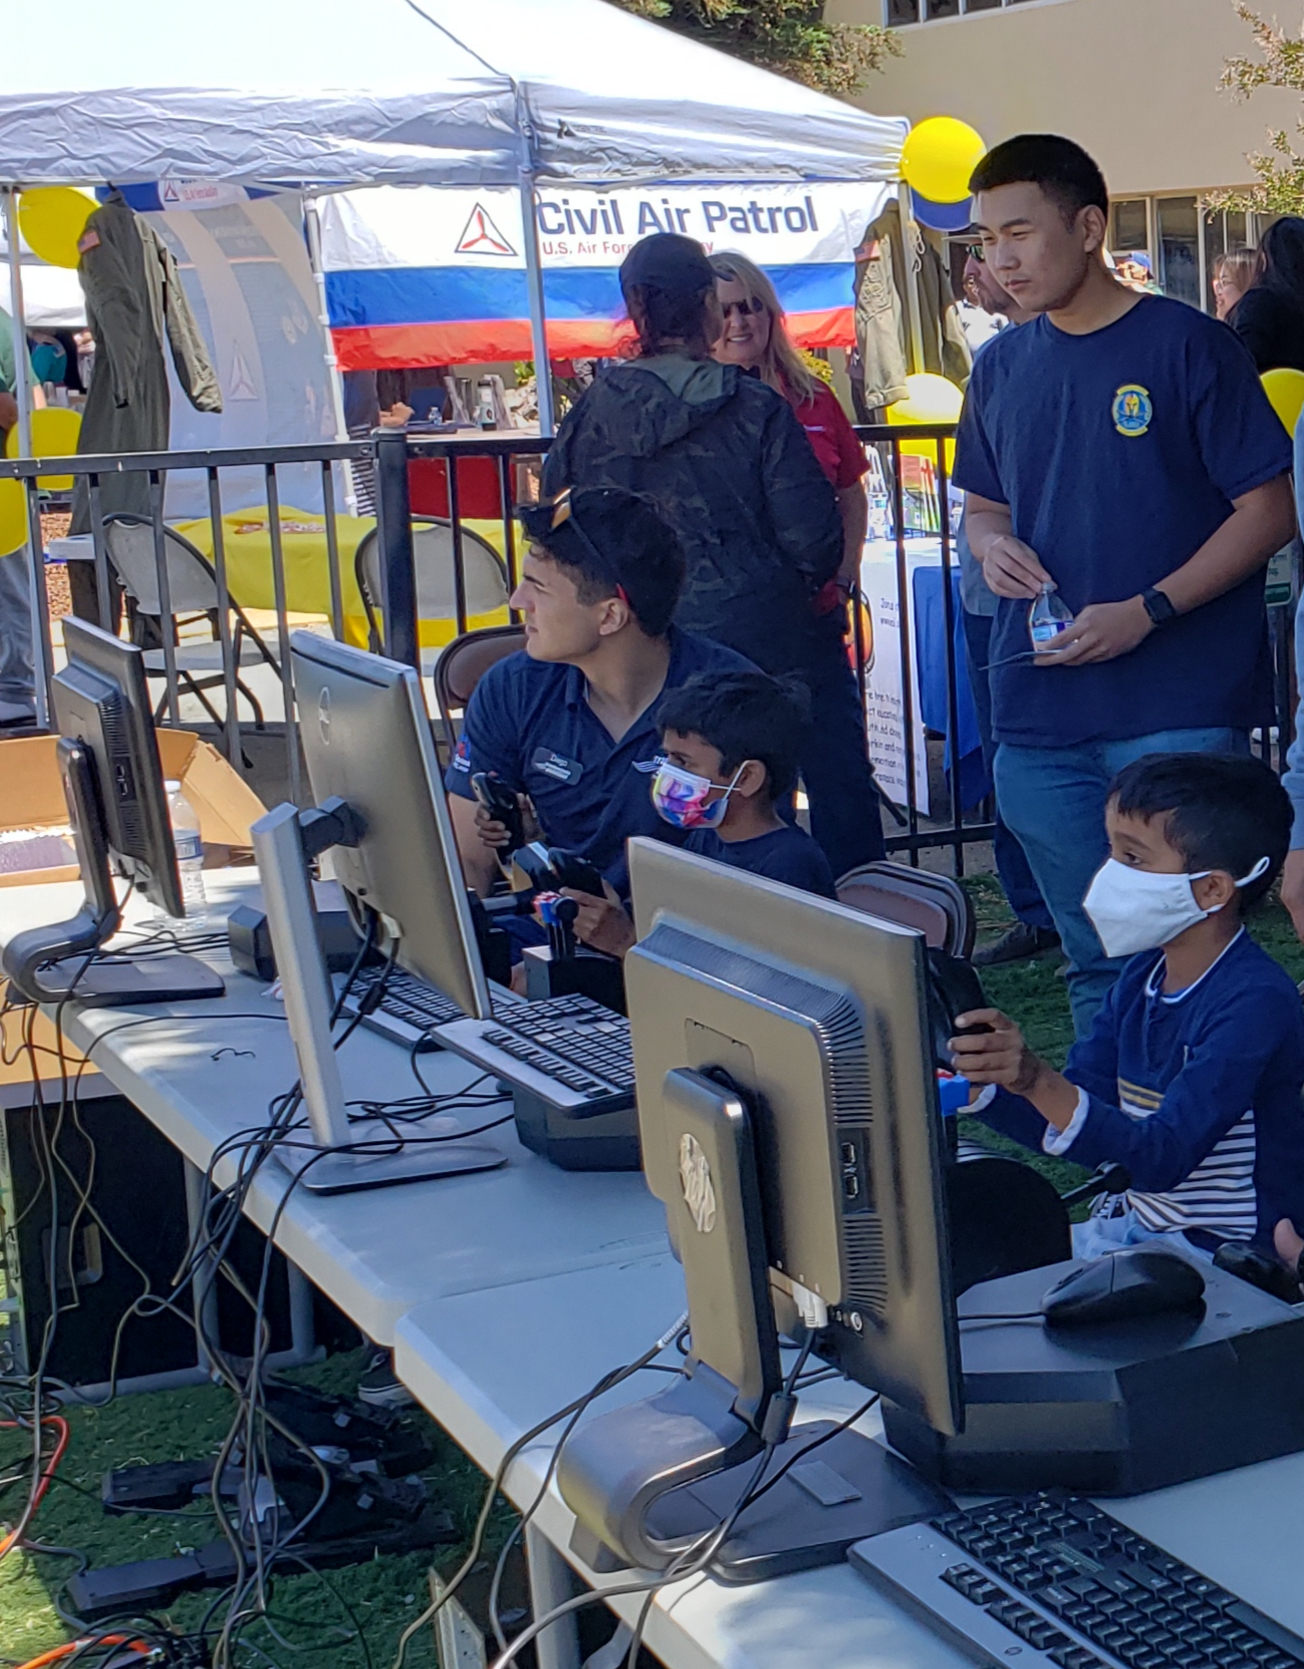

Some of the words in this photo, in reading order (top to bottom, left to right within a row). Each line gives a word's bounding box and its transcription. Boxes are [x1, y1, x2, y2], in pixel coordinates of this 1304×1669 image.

[537, 198, 625, 235] Civil
[637, 198, 691, 235] Air
[700, 195, 819, 235] Patrol
[542, 241, 573, 255] U.S.
[577, 241, 598, 255] Air
[602, 241, 633, 255] For
